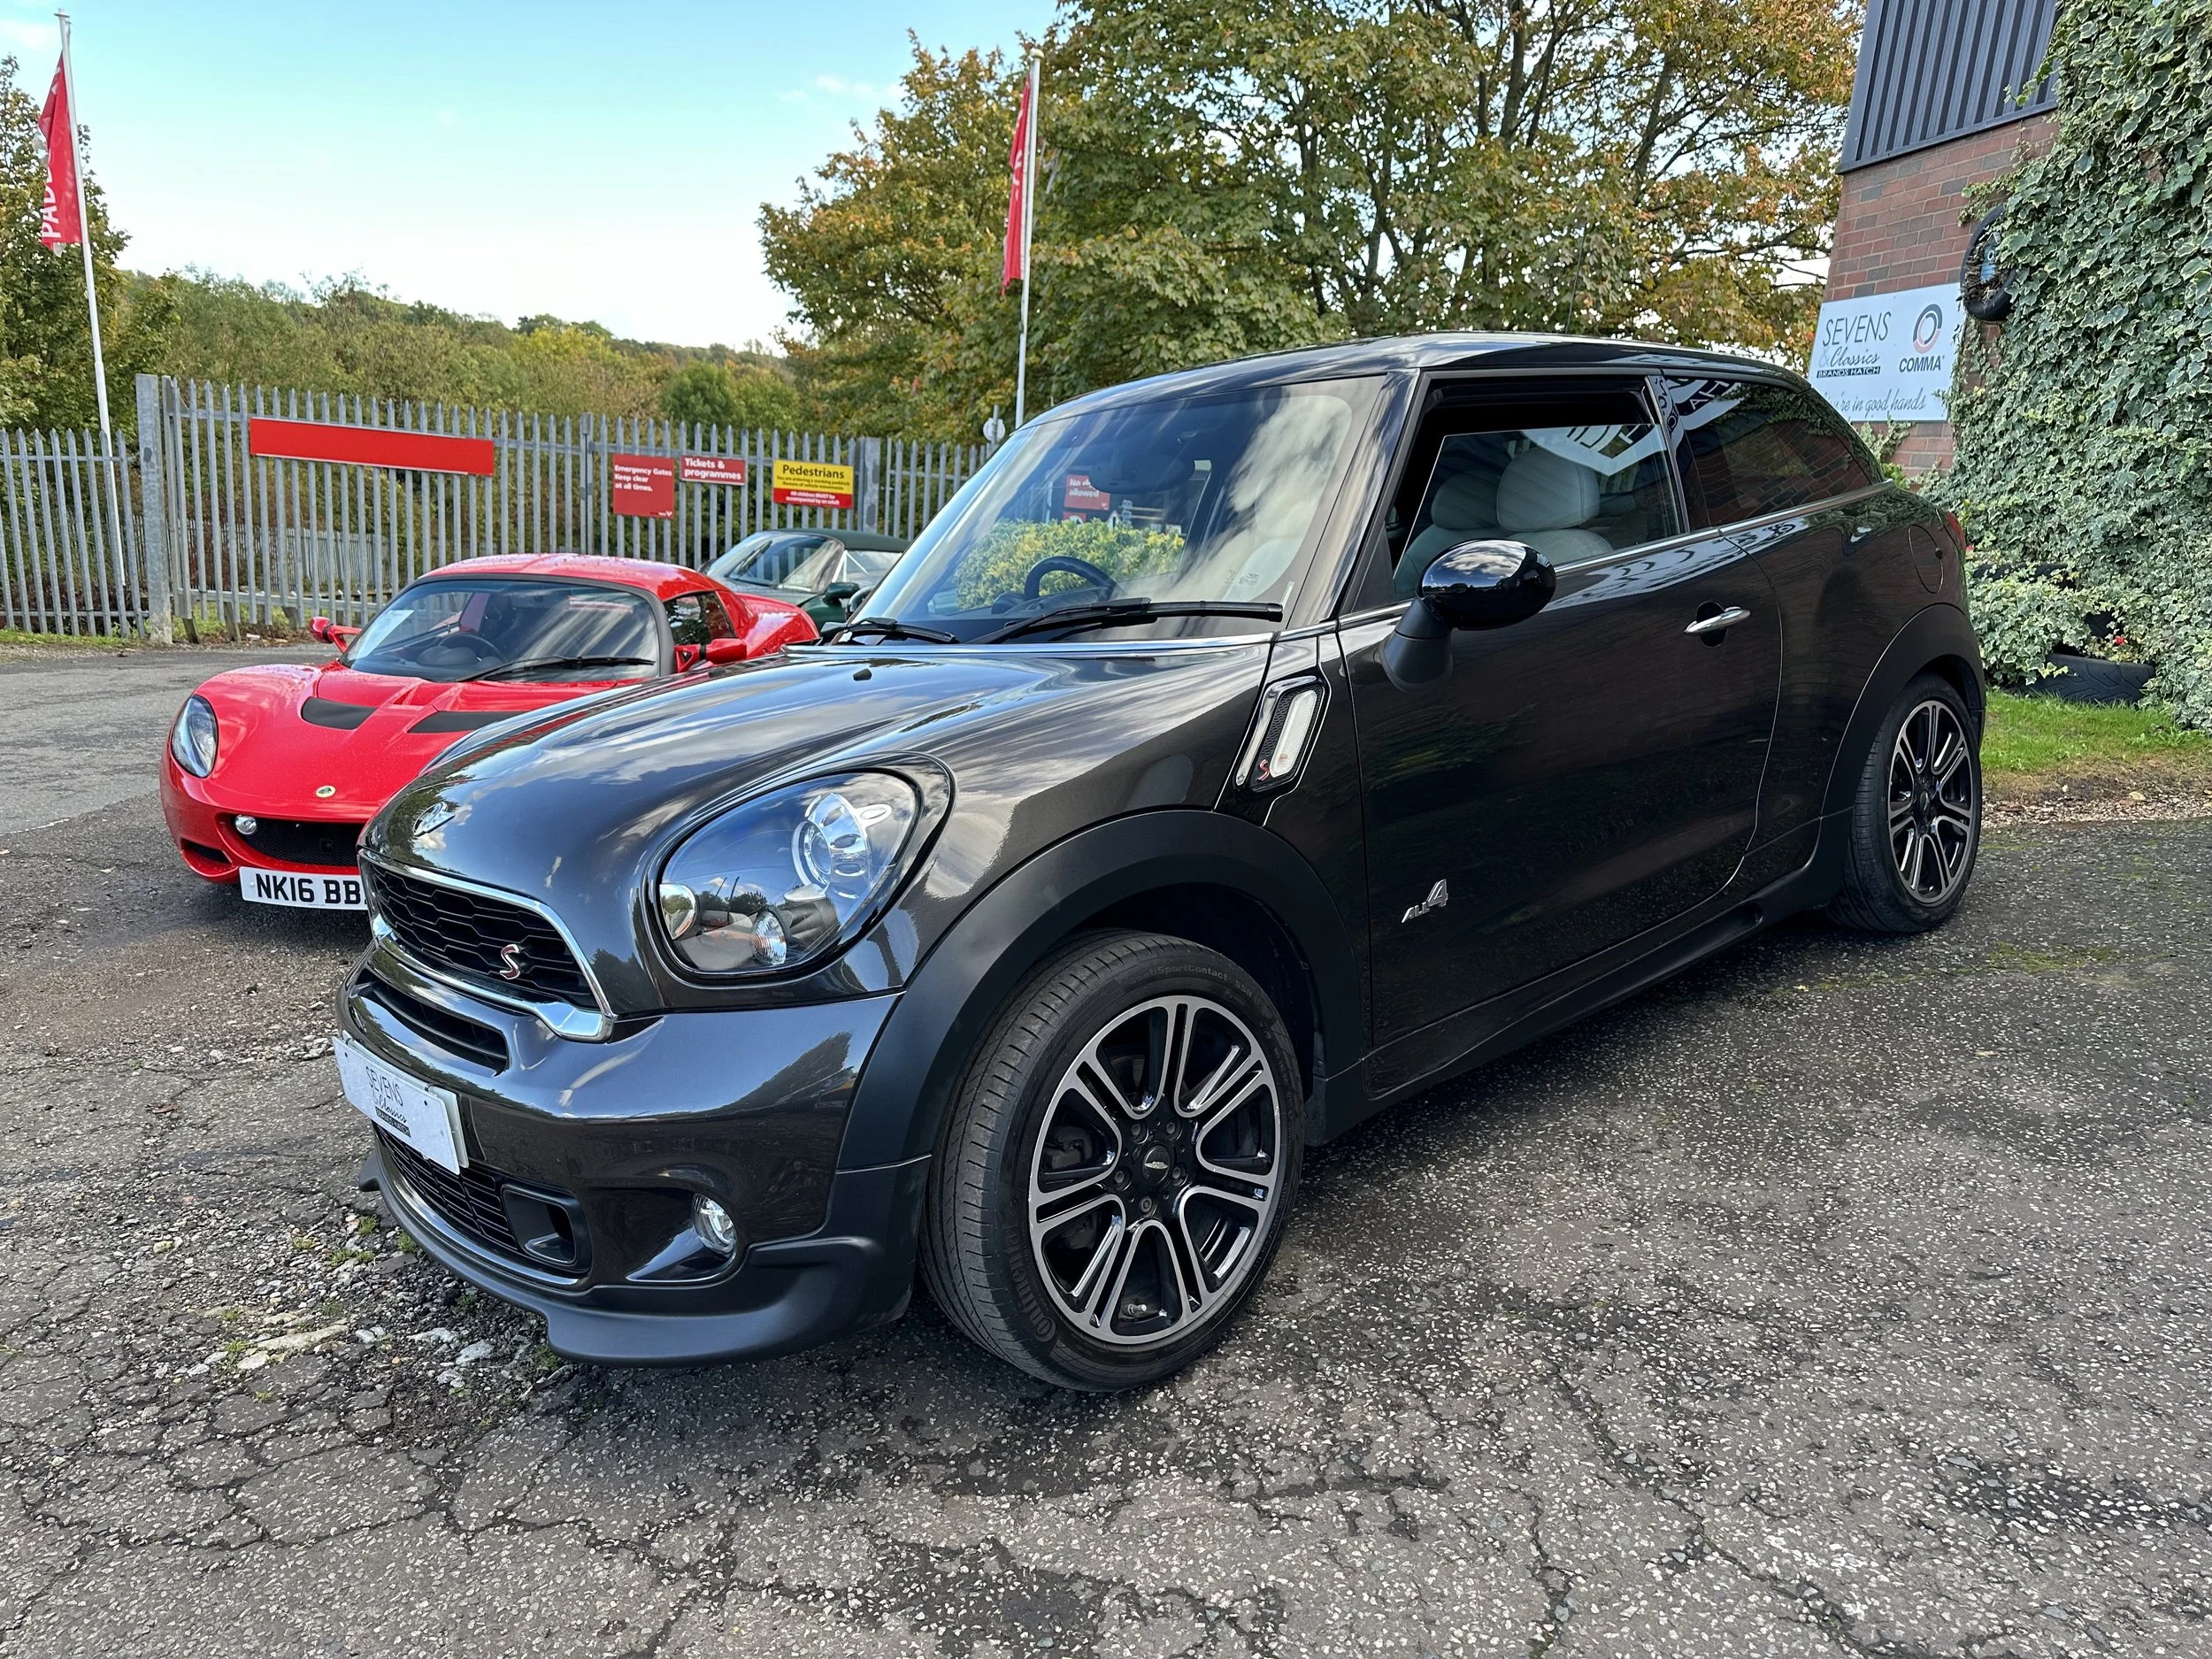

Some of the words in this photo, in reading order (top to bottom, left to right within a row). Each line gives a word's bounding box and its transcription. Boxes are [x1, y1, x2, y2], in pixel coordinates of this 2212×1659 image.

[1823, 311, 1892, 347] SEVENS
[1830, 346, 1880, 367] Classics
[1818, 368, 1849, 378] BRANDS
[1850, 366, 1880, 376] HATCH
[1899, 356, 1941, 373] COMMA
[1852, 396, 1863, 412] in
[1864, 388, 1889, 418] good
[1889, 388, 1926, 411] hands
[684, 457, 716, 469] Tickets
[718, 460, 726, 469] &
[614, 465, 652, 476] Emergency
[653, 468, 672, 477] Gates
[614, 473, 632, 482] Keep
[684, 469, 741, 480] programmes
[782, 464, 844, 479] Pedestrians
[633, 483, 653, 492] times.
[1070, 478, 1081, 487] No
[255, 872, 316, 903] NK16
[323, 879, 367, 905] BB
[499, 943, 521, 980] S
[365, 1065, 403, 1107] SEVENS
